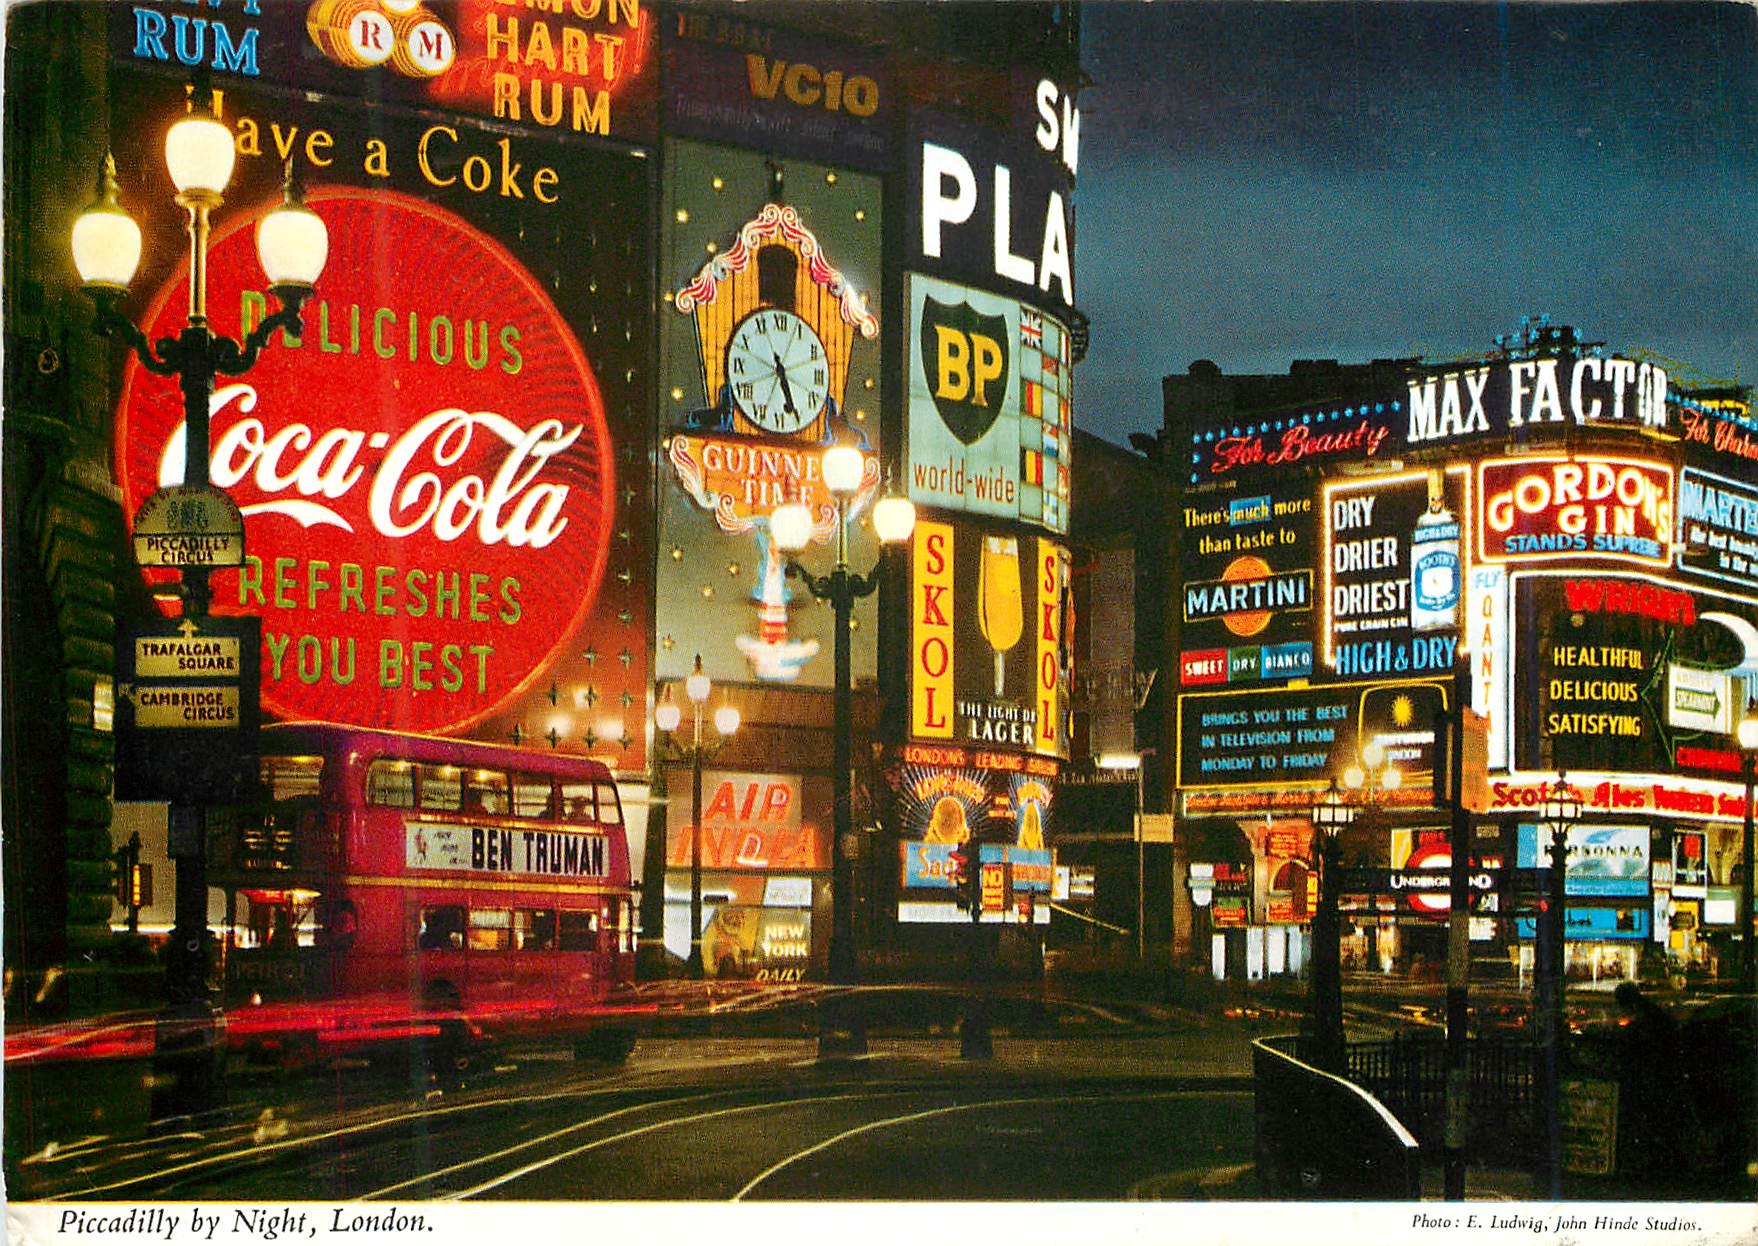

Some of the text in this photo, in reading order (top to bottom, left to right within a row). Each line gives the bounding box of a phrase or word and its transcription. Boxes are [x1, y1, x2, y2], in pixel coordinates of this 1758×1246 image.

[132, 7, 260, 76] RUM
[361, 20, 383, 50] R
[418, 30, 444, 61] M
[486, 12, 624, 81] HART
[746, 54, 880, 118] VC10
[494, 72, 611, 136] RUM
[364, 141, 391, 179] a
[418, 125, 561, 204] Coke
[923, 141, 1074, 306] PLA
[935, 325, 1003, 408] BP
[1406, 359, 1668, 444] MAX FACTOR
[1266, 420, 1389, 465] Beauty
[158, 384, 584, 550] Coca-Cola
[913, 456, 1016, 504] world-wide
[1183, 499, 1312, 529] There's much more
[1334, 496, 1375, 532] DRY
[1487, 462, 1670, 543] GORDON'S
[1557, 504, 1635, 536] GIN
[147, 536, 230, 551] PICCADILLY
[1199, 527, 1297, 555] than taste to
[1335, 537, 1398, 574] DRIER
[1505, 534, 1588, 553] STANDS
[161, 551, 214, 563] CIRCUS
[239, 556, 523, 624] REFRESHES
[1474, 571, 1502, 588] FLY
[1186, 578, 1306, 616] MARTINI
[1334, 578, 1410, 617] DRIEST
[921, 535, 950, 728] SKOL
[142, 643, 222, 656] TRAFALGAR
[178, 656, 235, 670] SQUARE
[1041, 555, 1057, 741] SKOL
[1265, 652, 1310, 670] BIANCO
[1335, 636, 1458, 675] HIGH & DRY
[1553, 646, 1643, 670] HEALTHFUL
[266, 635, 495, 693] YOU BEST
[1185, 660, 1223, 676] SWEET
[1233, 657, 1256, 671] DRY
[141, 693, 223, 706] CAMBRIDGE
[1550, 680, 1639, 702] DELICIOUS
[184, 706, 235, 720] CIRCUS
[987, 705, 1018, 721] LIGHT
[1201, 705, 1347, 727] BRINGS YOU THE BEST
[1549, 714, 1641, 736] SATISFYING
[971, 719, 1035, 745] LAGER
[1201, 727, 1335, 748] IN TELEVISION FROM
[1201, 752, 1327, 771] MONDAY TO FRIDAY
[703, 781, 792, 823] AIR
[1492, 782, 1583, 807] Scoth
[472, 828, 512, 871] BEN
[523, 831, 603, 875] TRUMAN
[763, 925, 805, 939] NEW
[761, 942, 808, 957] YORK
[756, 969, 807, 981] DAILY
